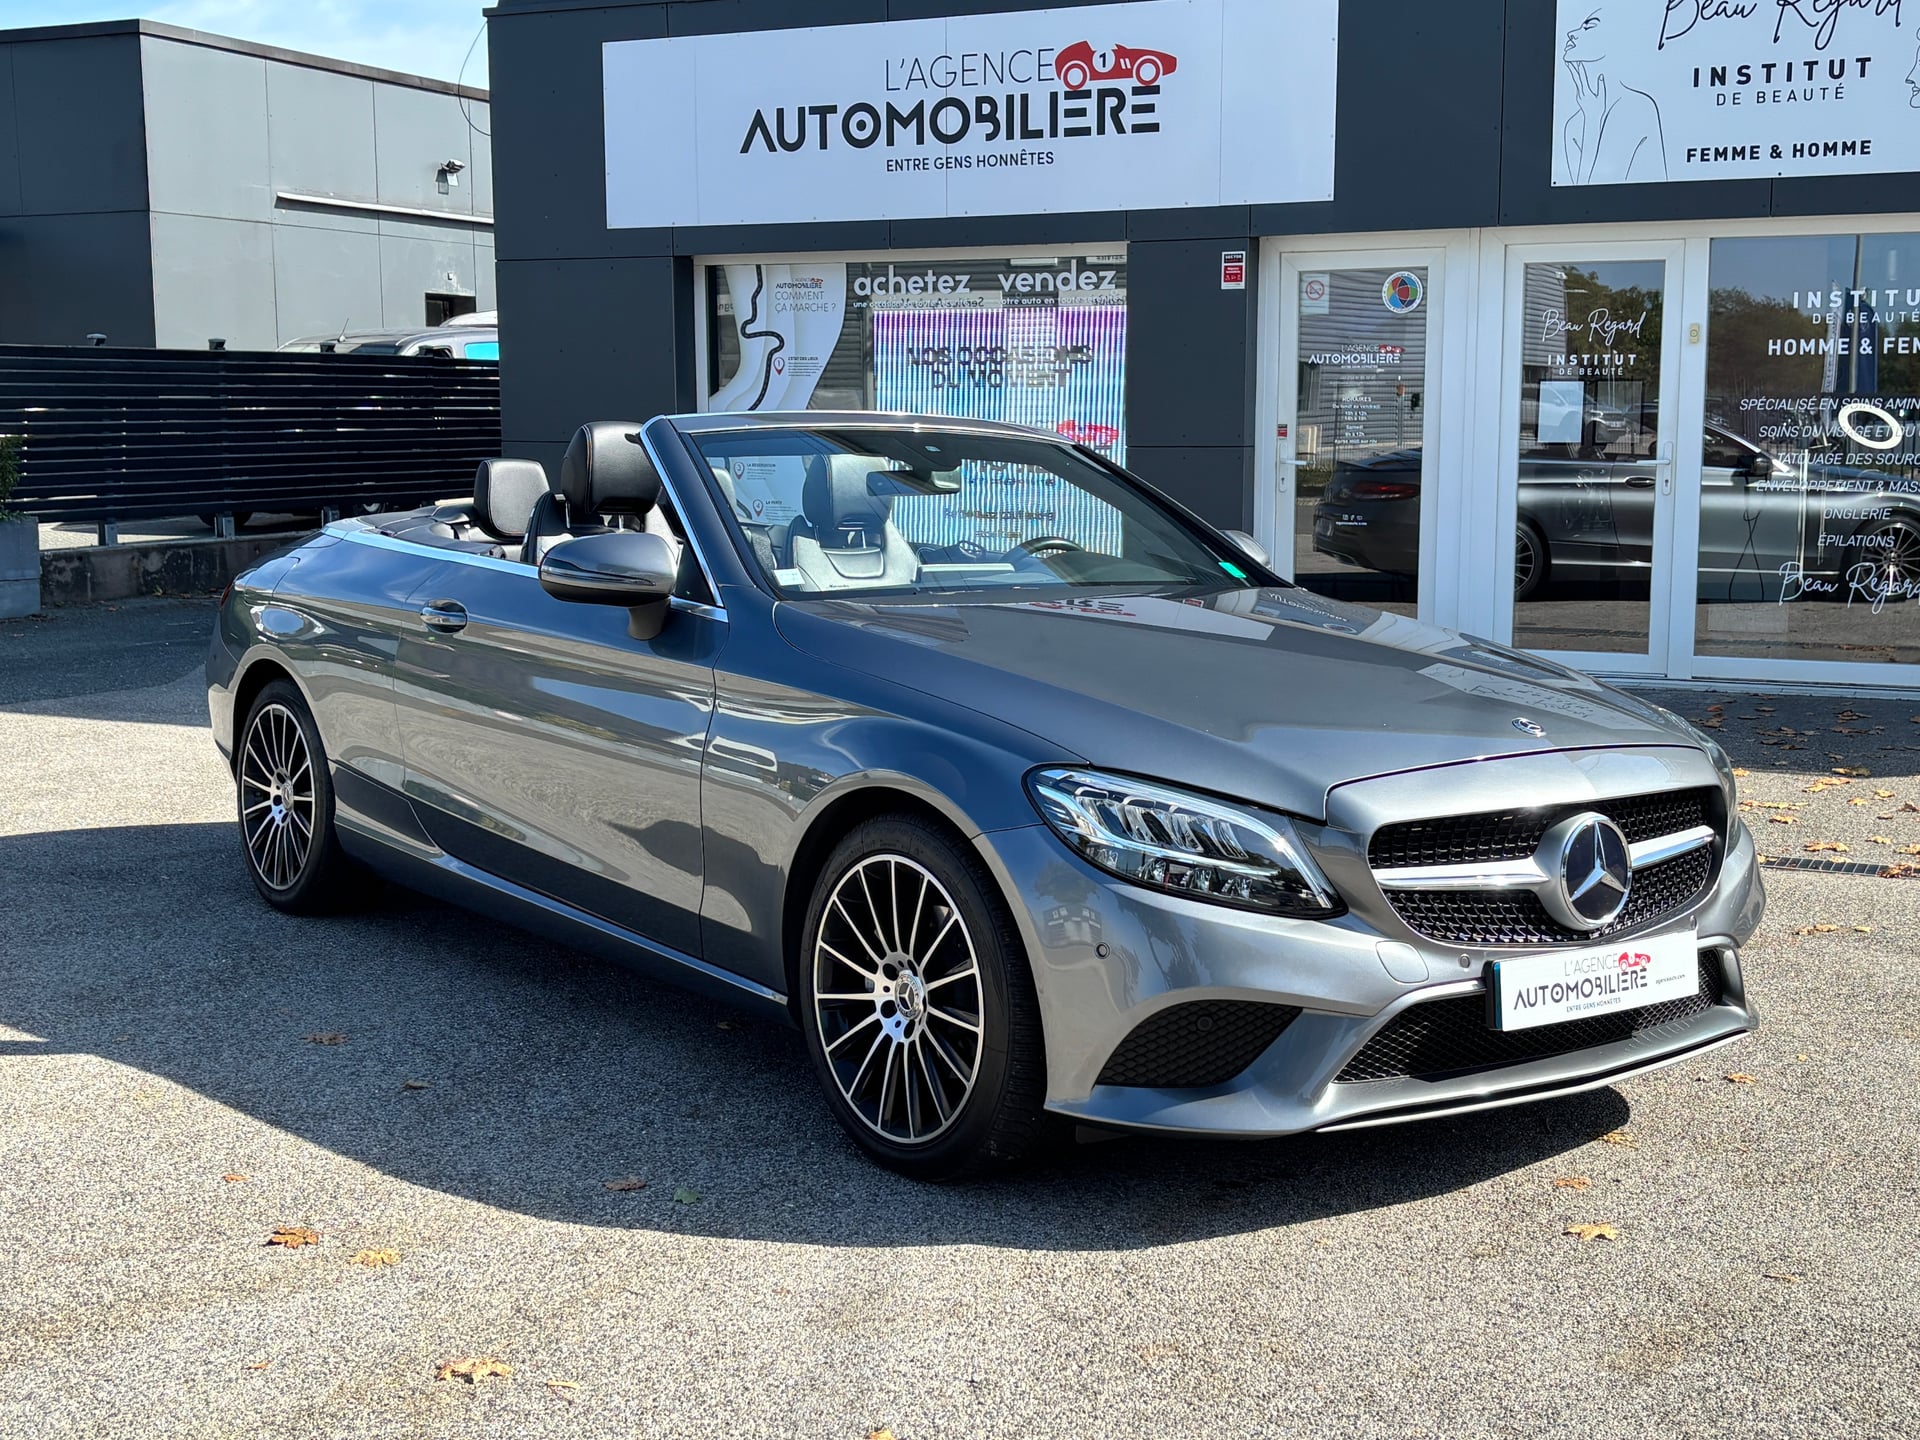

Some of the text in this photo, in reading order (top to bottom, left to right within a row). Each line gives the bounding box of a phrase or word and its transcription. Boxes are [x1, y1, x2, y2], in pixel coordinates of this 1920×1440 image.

[1098, 51, 1107, 69] 1
[885, 47, 1055, 92] L'AGENCE
[1693, 57, 1872, 88] INSTITUT
[1716, 82, 1845, 106] DE BEAUTÉ
[1686, 140, 1872, 163] FEMME & HOMME
[886, 149, 1055, 173] ENTRE GENS HONNÊTES
[853, 264, 971, 297] achetez
[998, 259, 1117, 293] vendez
[775, 291, 824, 301] COMMENT
[1001, 297, 1020, 305] otre
[1021, 296, 1042, 305] auto
[1044, 296, 1055, 304] en
[1793, 289, 1920, 309] INSTITU
[775, 302, 836, 314] ÇA MARCHE ?
[1813, 308, 1920, 324] DE BEAUTÉ
[1542, 308, 1646, 346] Beau Regard
[1768, 338, 1850, 356] HOMME
[1859, 337, 1873, 355] &
[1547, 354, 1637, 366] INSTITUT
[1559, 366, 1624, 376] DE BEAUTÉ
[1739, 395, 1817, 411] SPÉCIALISÉ
[1819, 399, 1838, 410] EN
[1759, 425, 1799, 438] SOINS
[1802, 425, 1823, 437] DU
[1875, 425, 1892, 437] ET
[1778, 452, 1843, 466] TATOUAGE
[1845, 452, 1872, 465] DES
[1756, 480, 1874, 493] ENVELOPPEMENT
[1876, 480, 1884, 492] &
[1823, 508, 1892, 520] ONGLERIE
[1817, 532, 1895, 547] ÉPILATIONS
[1779, 561, 1839, 606] Beau
[1564, 953, 1619, 977] L'AGENCE
